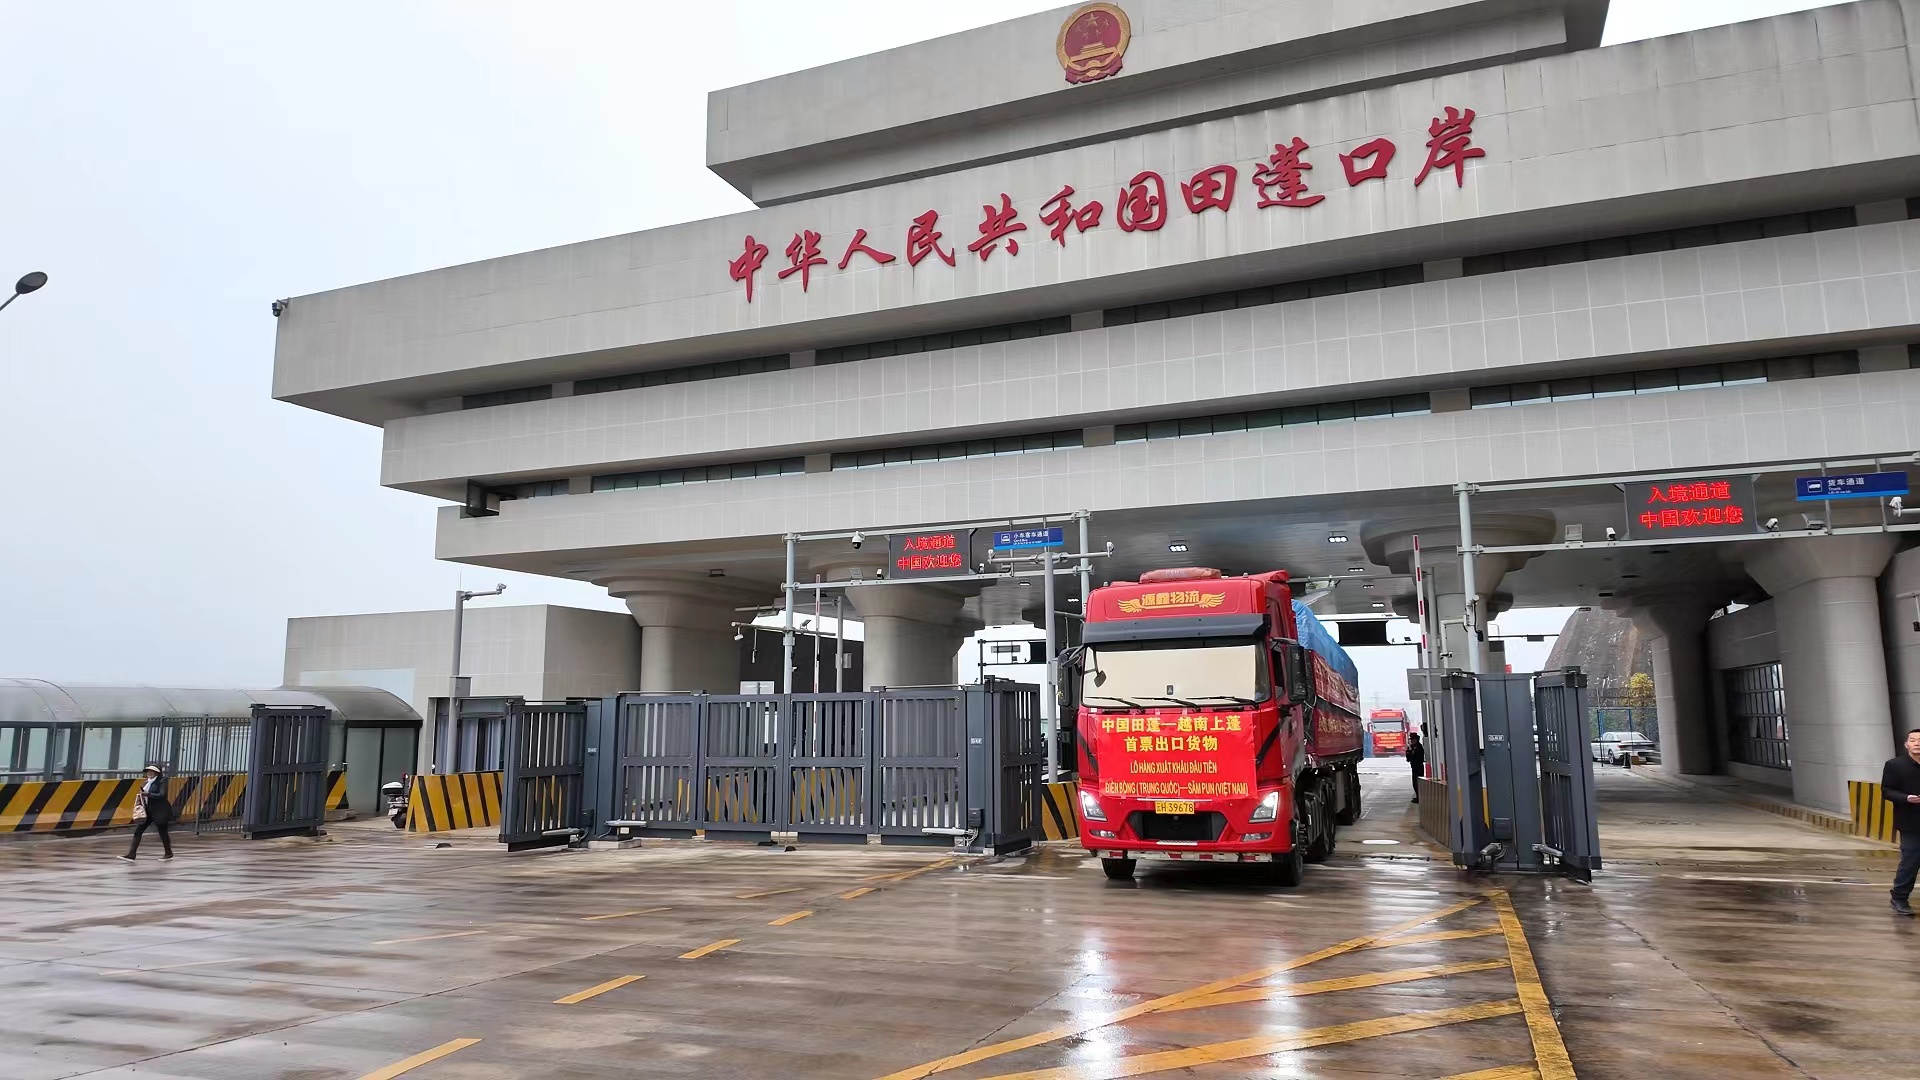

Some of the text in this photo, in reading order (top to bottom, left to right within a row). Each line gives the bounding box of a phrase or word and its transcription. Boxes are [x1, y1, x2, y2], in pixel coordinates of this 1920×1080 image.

[728, 106, 1485, 302] 中华人民共和国田蓬口岸
[1827, 477, 1865, 487] 货车通道
[1647, 481, 1731, 504] 入境通道
[1640, 505, 1744, 529] 中国欢迎您
[903, 534, 956, 551] 入境通道
[897, 553, 962, 570] 中国欢迎您
[1124, 735, 1218, 752] 首票出口货物
